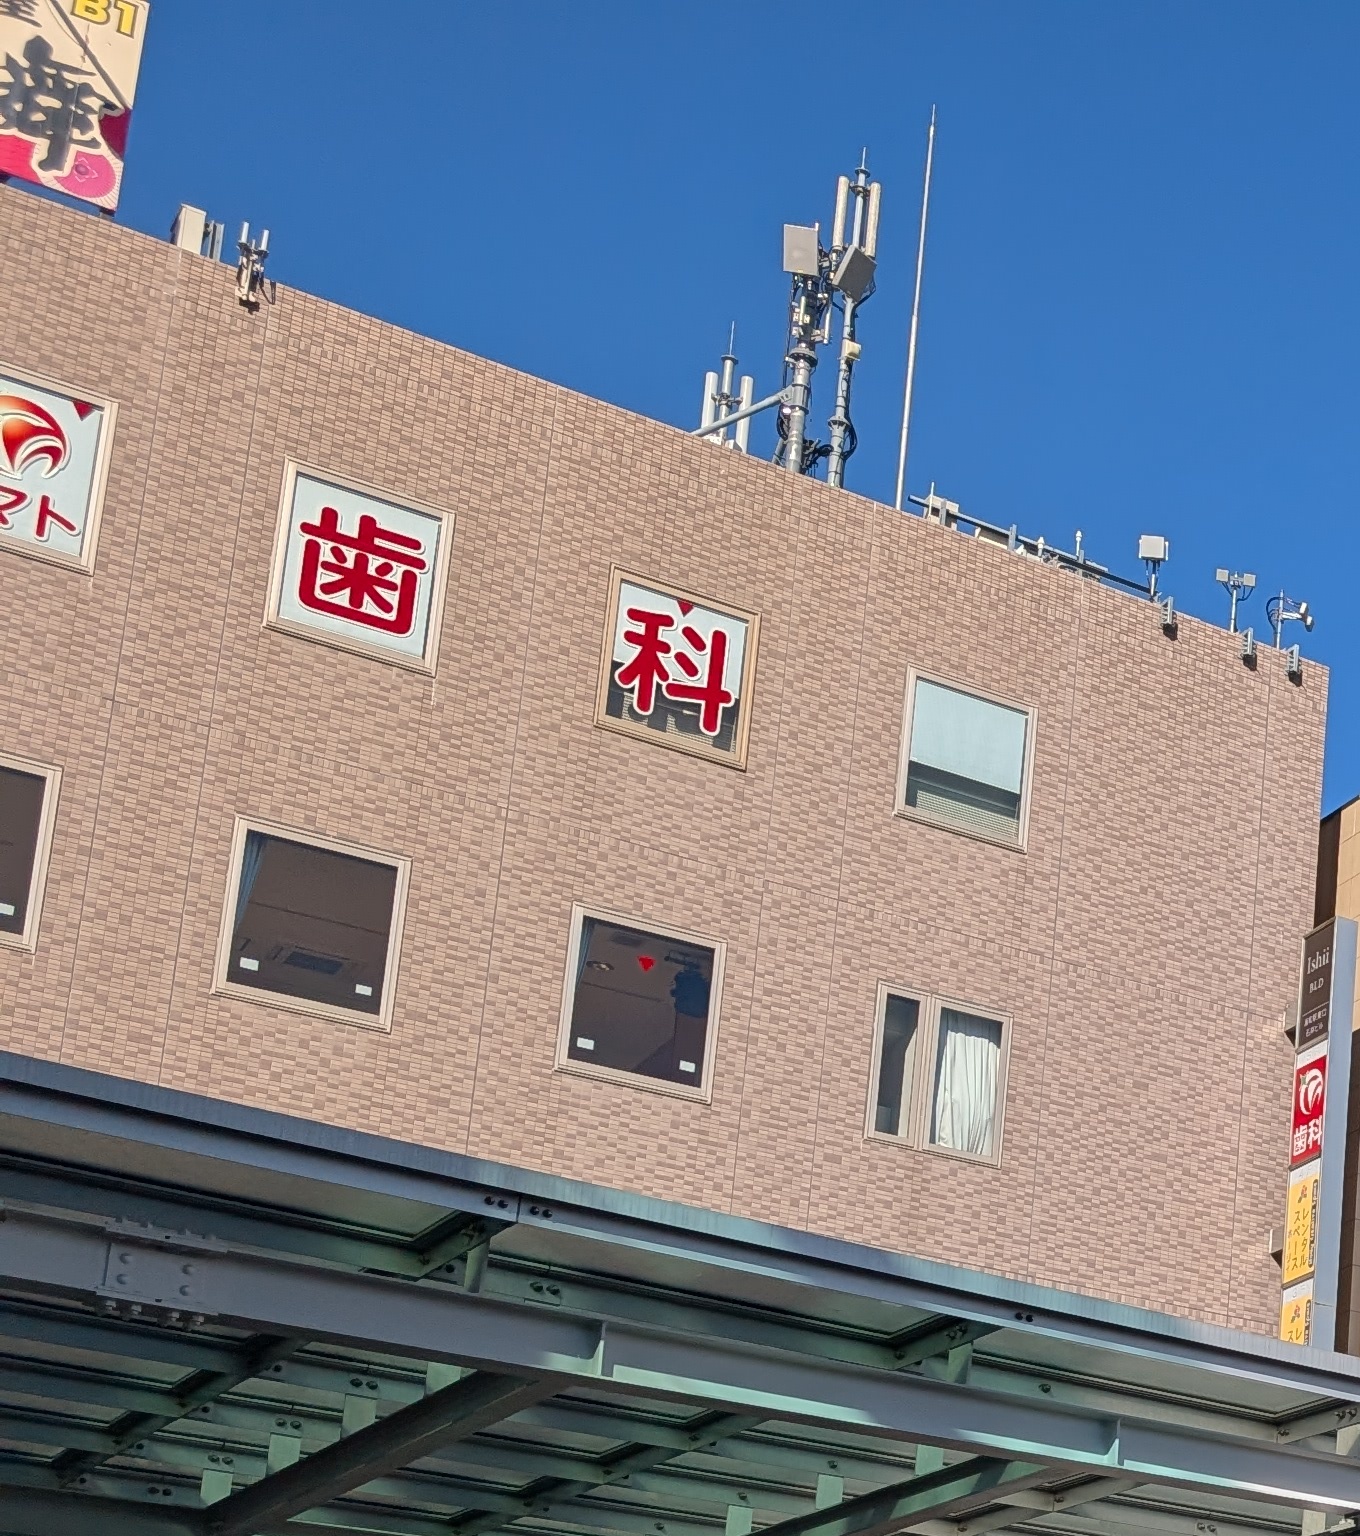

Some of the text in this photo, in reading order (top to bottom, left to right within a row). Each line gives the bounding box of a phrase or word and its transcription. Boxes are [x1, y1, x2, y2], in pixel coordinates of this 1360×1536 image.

[300, 506, 429, 635] 歯
[616, 606, 733, 735] 科
[1307, 947, 1329, 974] Ishii
[1309, 977, 1324, 994] BLD
[1293, 1115, 1322, 1156] 歯科
